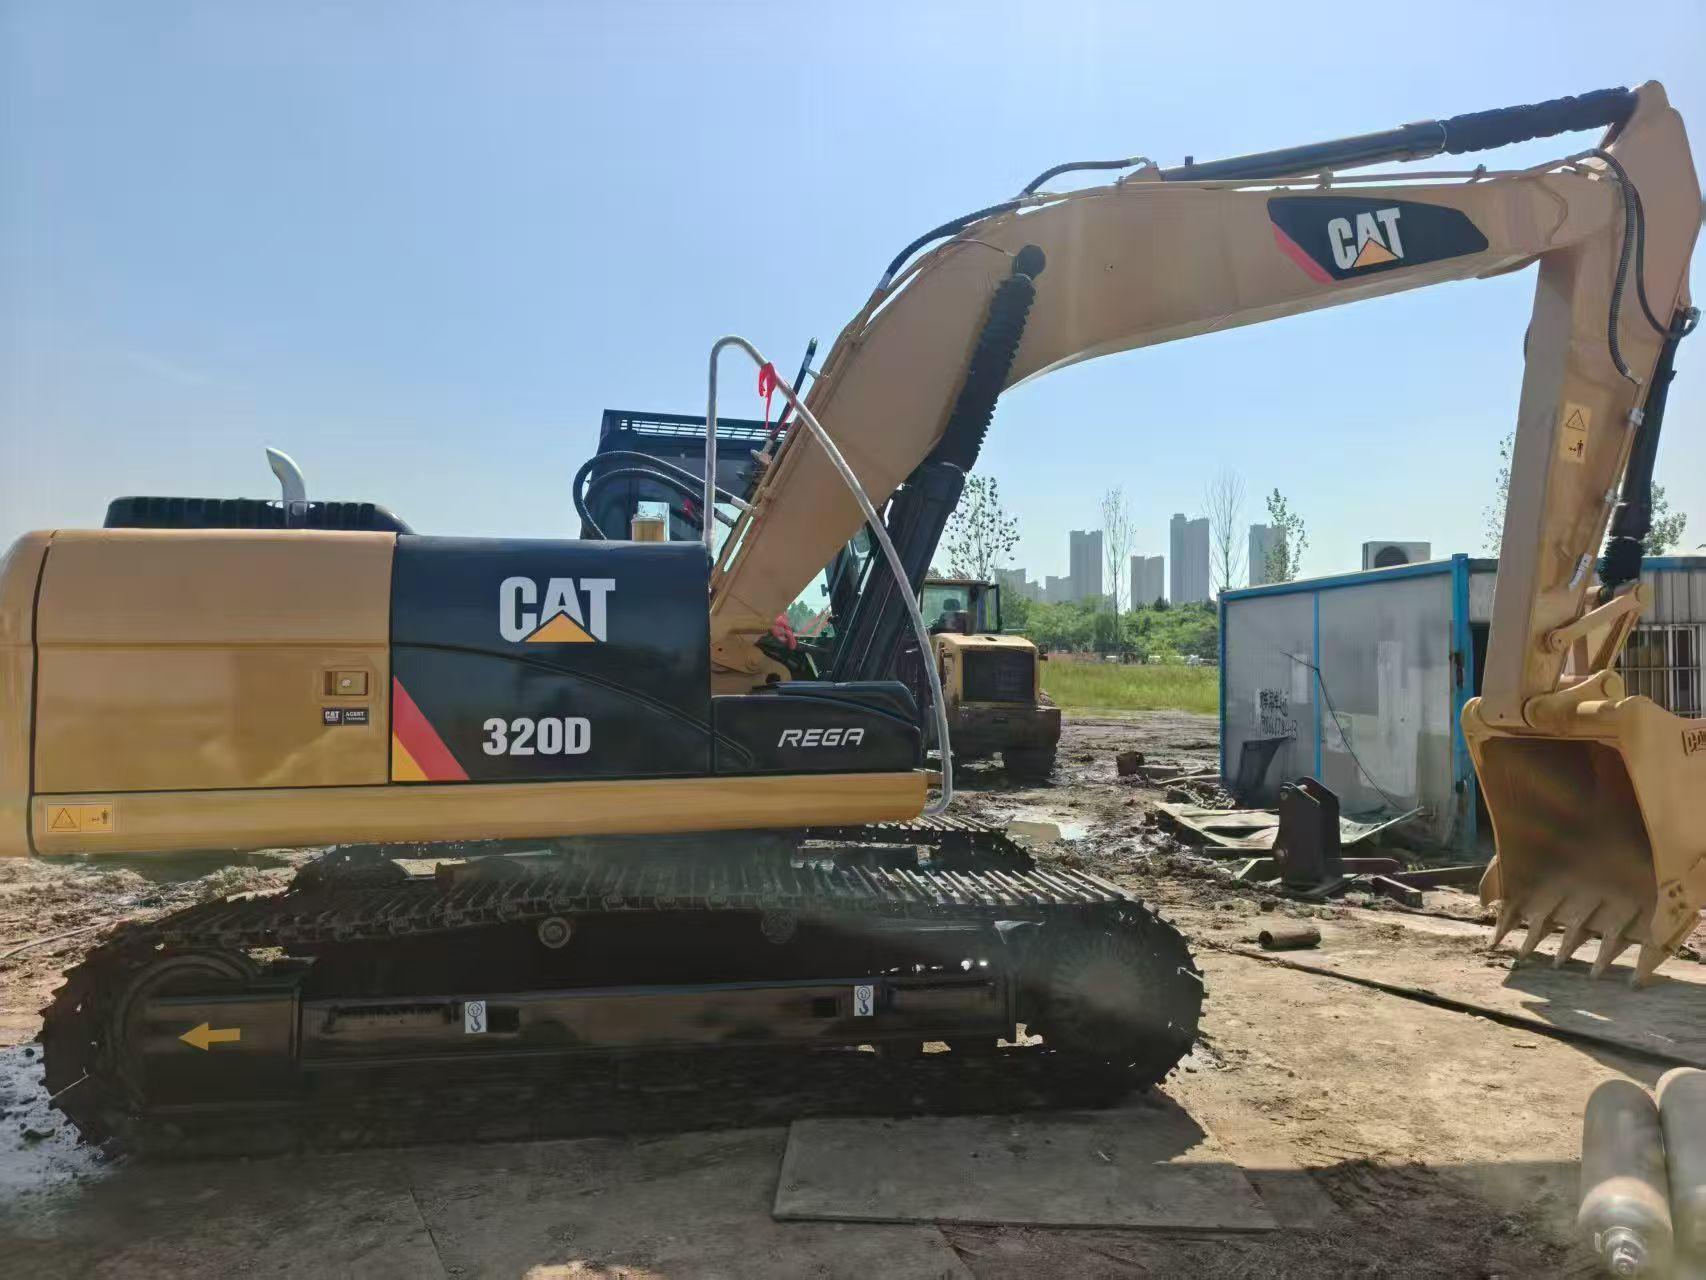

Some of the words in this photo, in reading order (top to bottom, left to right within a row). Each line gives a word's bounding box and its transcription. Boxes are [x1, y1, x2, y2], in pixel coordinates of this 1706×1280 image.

[1327, 207, 1404, 270] CAT
[500, 576, 616, 643] CAT
[325, 710, 340, 720] CAT
[482, 717, 591, 756] 320D
[777, 727, 865, 747] REGA
